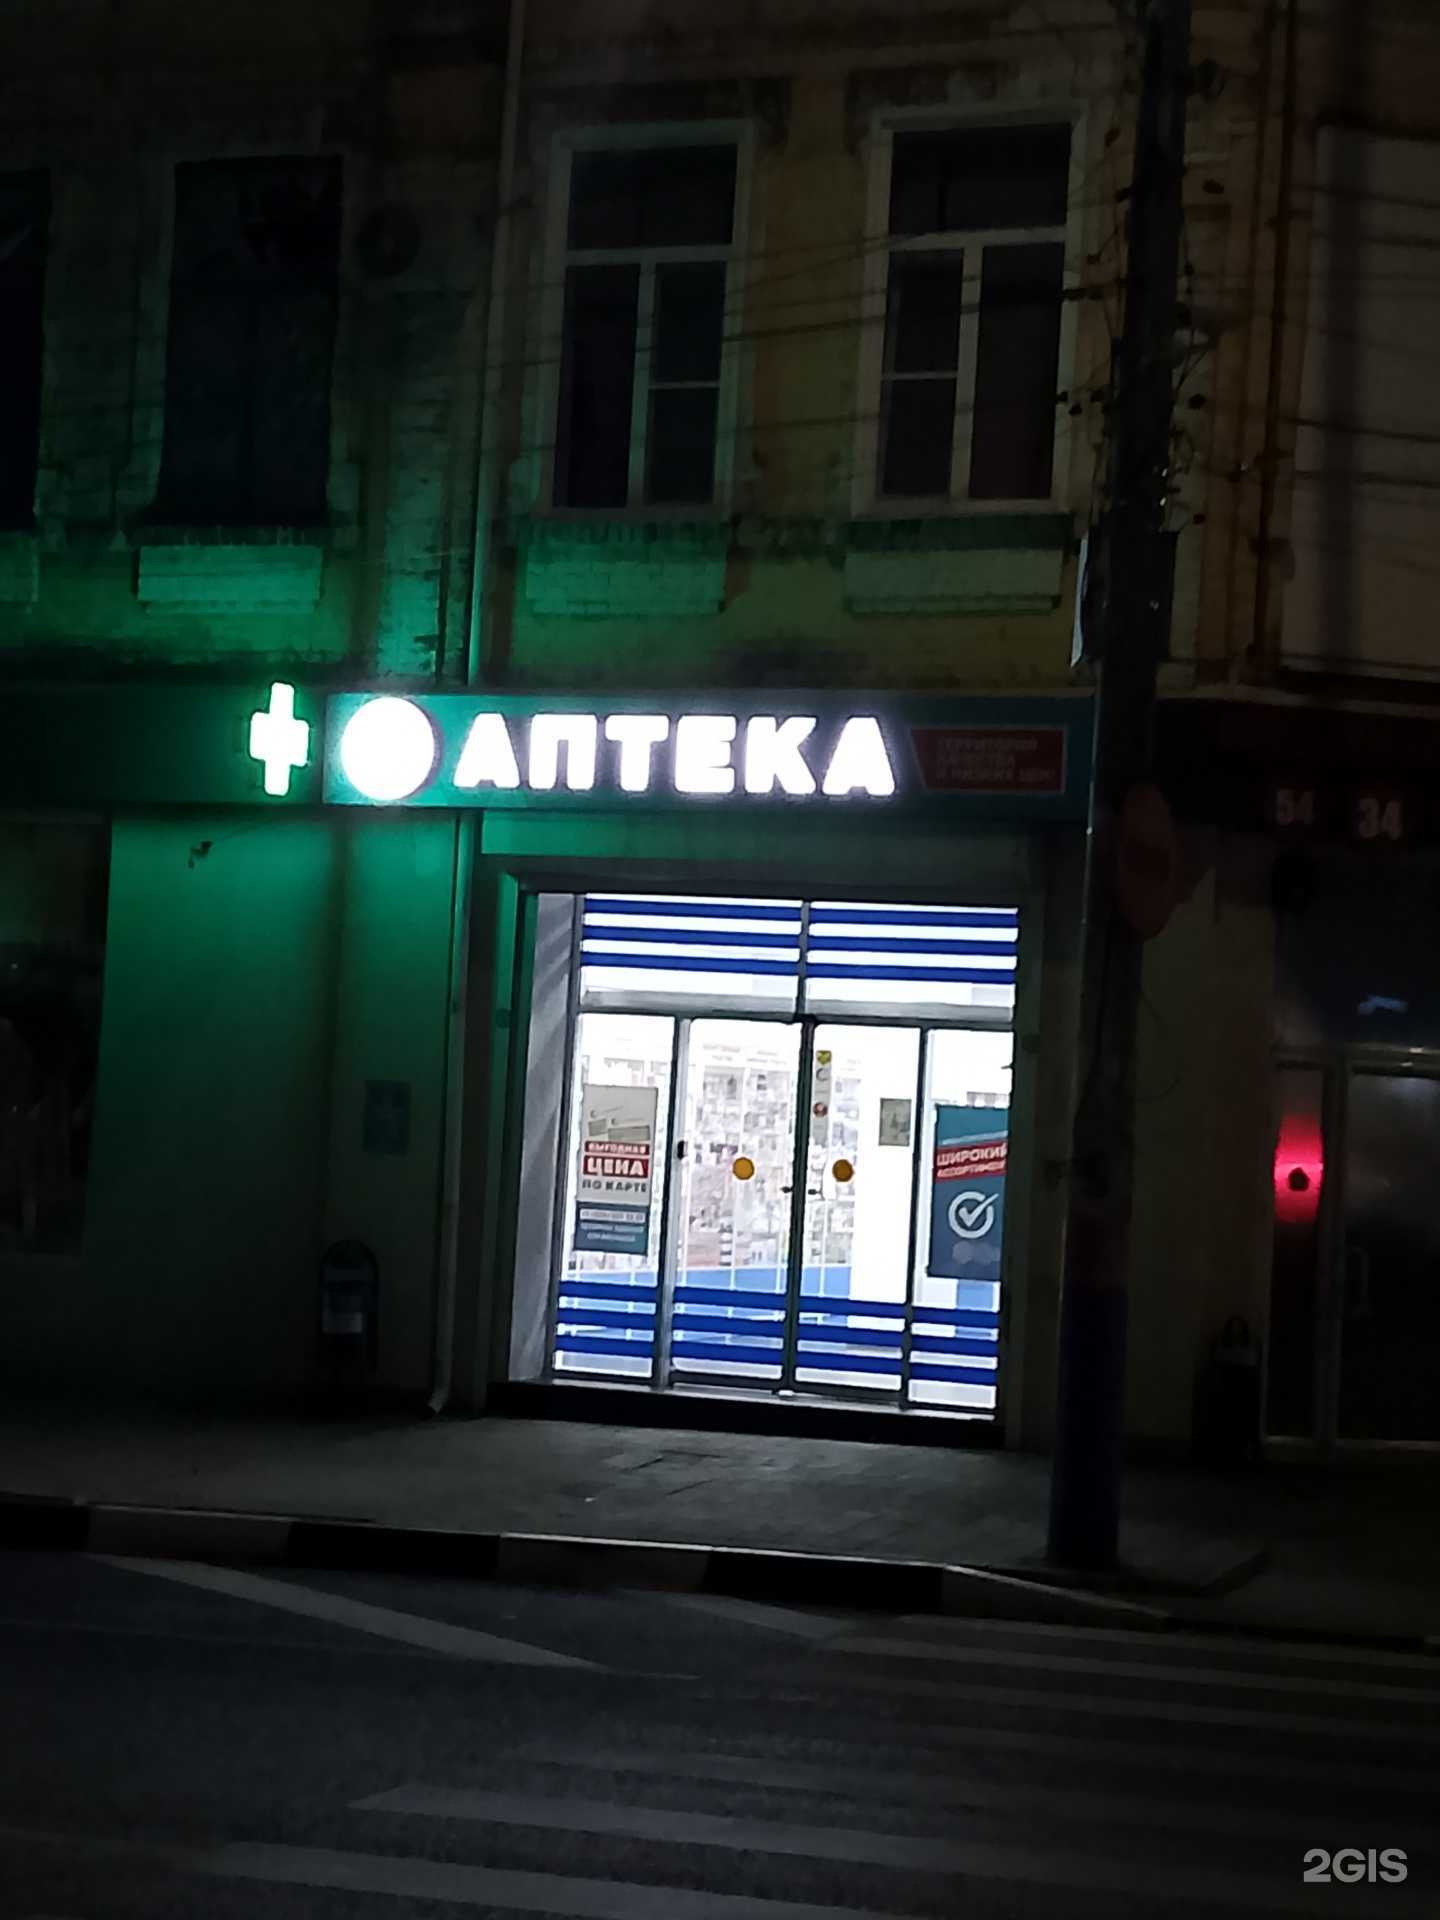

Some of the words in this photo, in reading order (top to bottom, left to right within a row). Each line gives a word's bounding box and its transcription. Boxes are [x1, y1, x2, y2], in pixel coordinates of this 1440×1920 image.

[453, 712, 896, 797] АПТЕКА
[1358, 797, 1402, 840] 34
[587, 1157, 644, 1176] ЦЕНА
[582, 1179, 602, 1190] ПО
[605, 1181, 647, 1193] КАРТЕ
